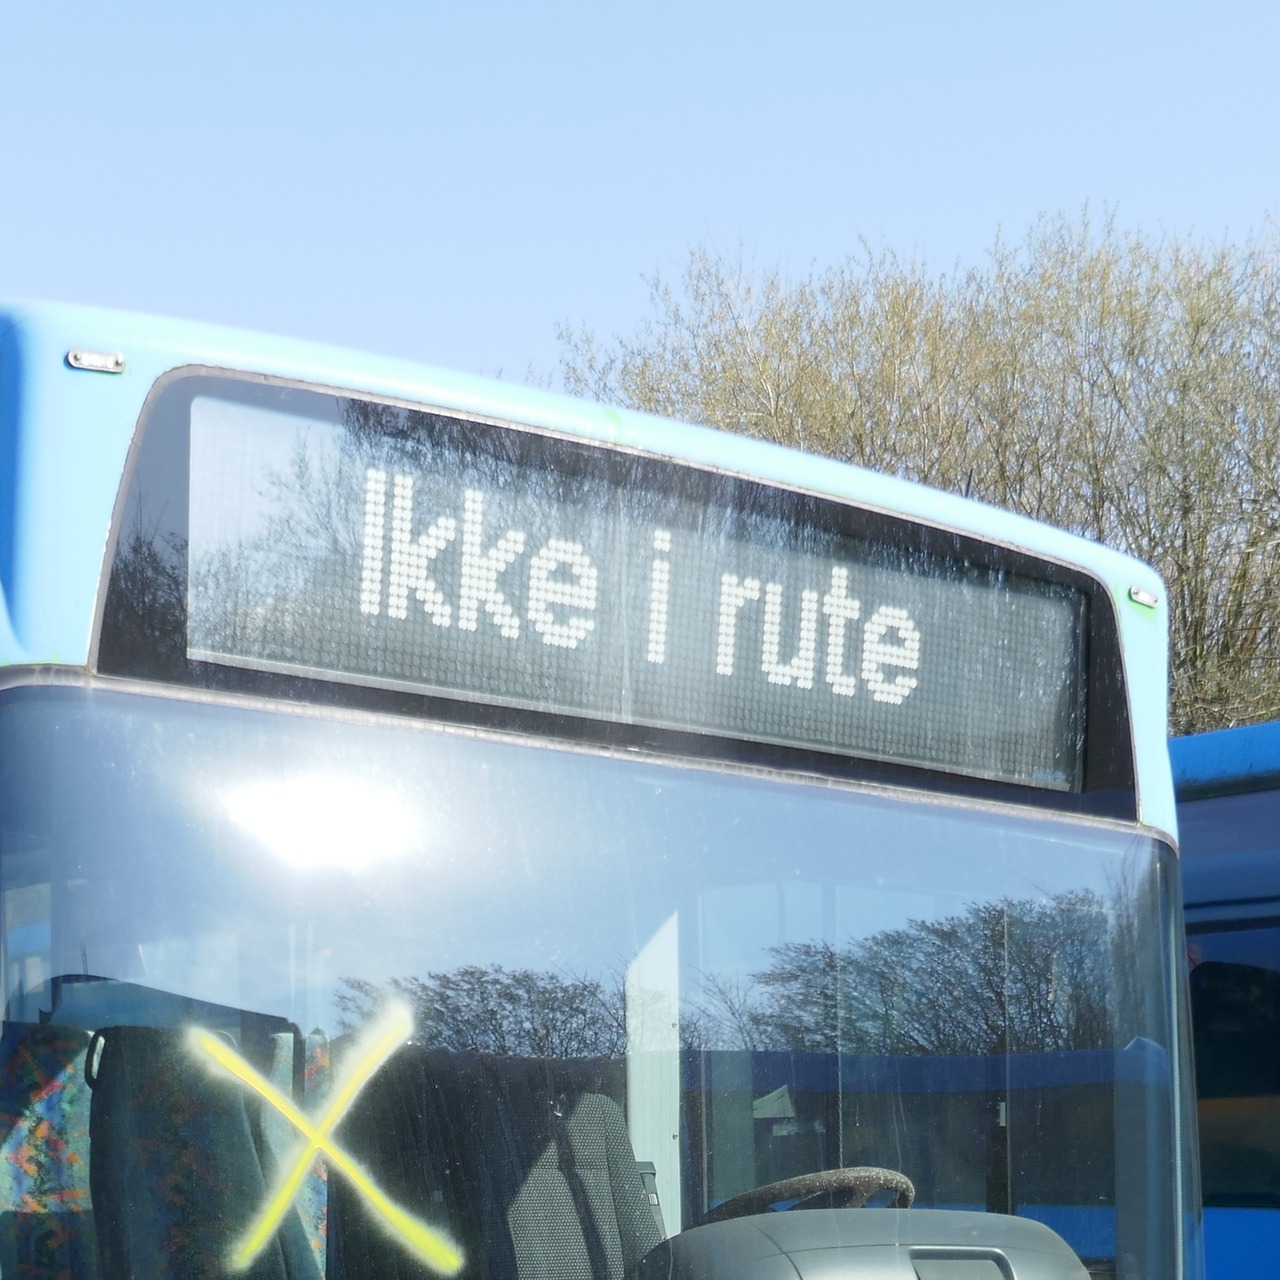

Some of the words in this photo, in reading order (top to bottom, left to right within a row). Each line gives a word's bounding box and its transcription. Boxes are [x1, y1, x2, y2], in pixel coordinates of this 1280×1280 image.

[360, 468, 597, 649] Ikke
[647, 530, 670, 665] i
[716, 566, 920, 705] rute
